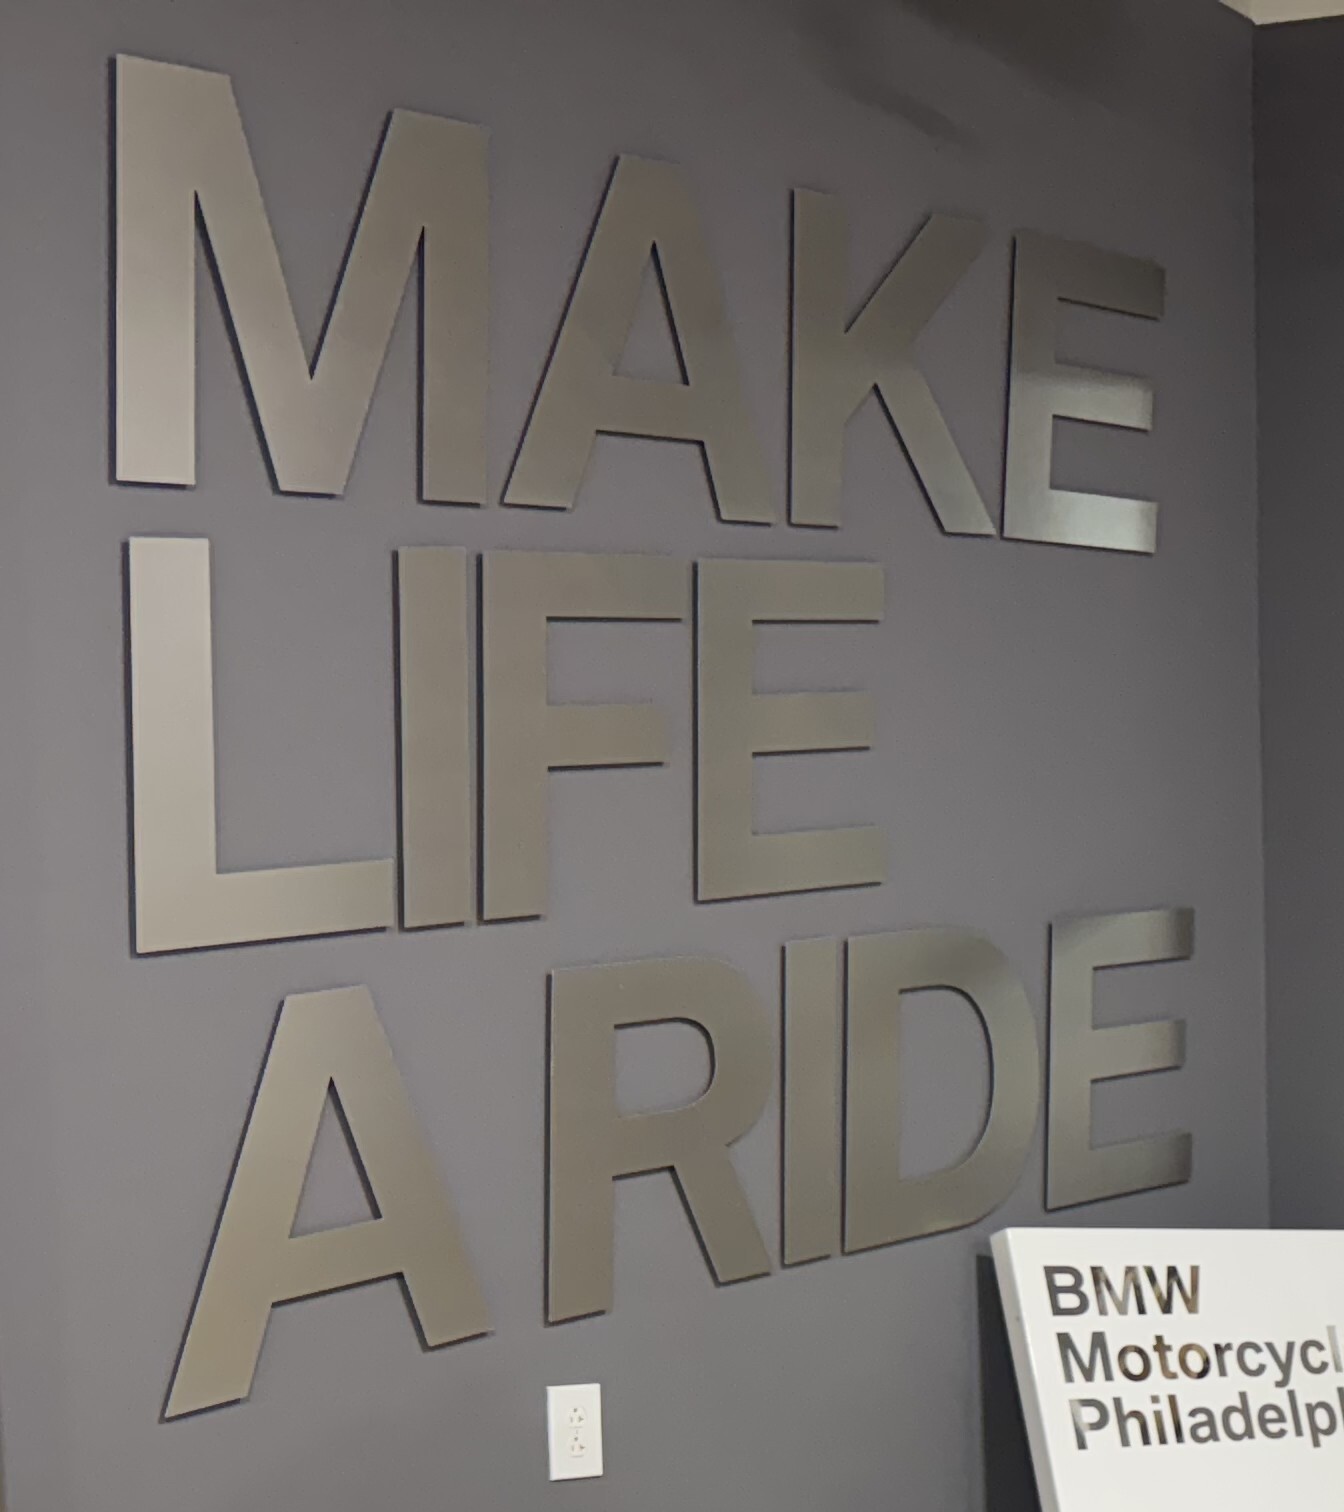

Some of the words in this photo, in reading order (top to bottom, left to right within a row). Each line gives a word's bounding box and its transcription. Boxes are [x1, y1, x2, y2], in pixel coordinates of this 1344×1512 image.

[112, 53, 1166, 554] MAKE
[126, 536, 885, 956] LIFE
[162, 983, 496, 1422] A
[546, 907, 1195, 1326] RIDE
[1043, 1264, 1201, 1317] BMW
